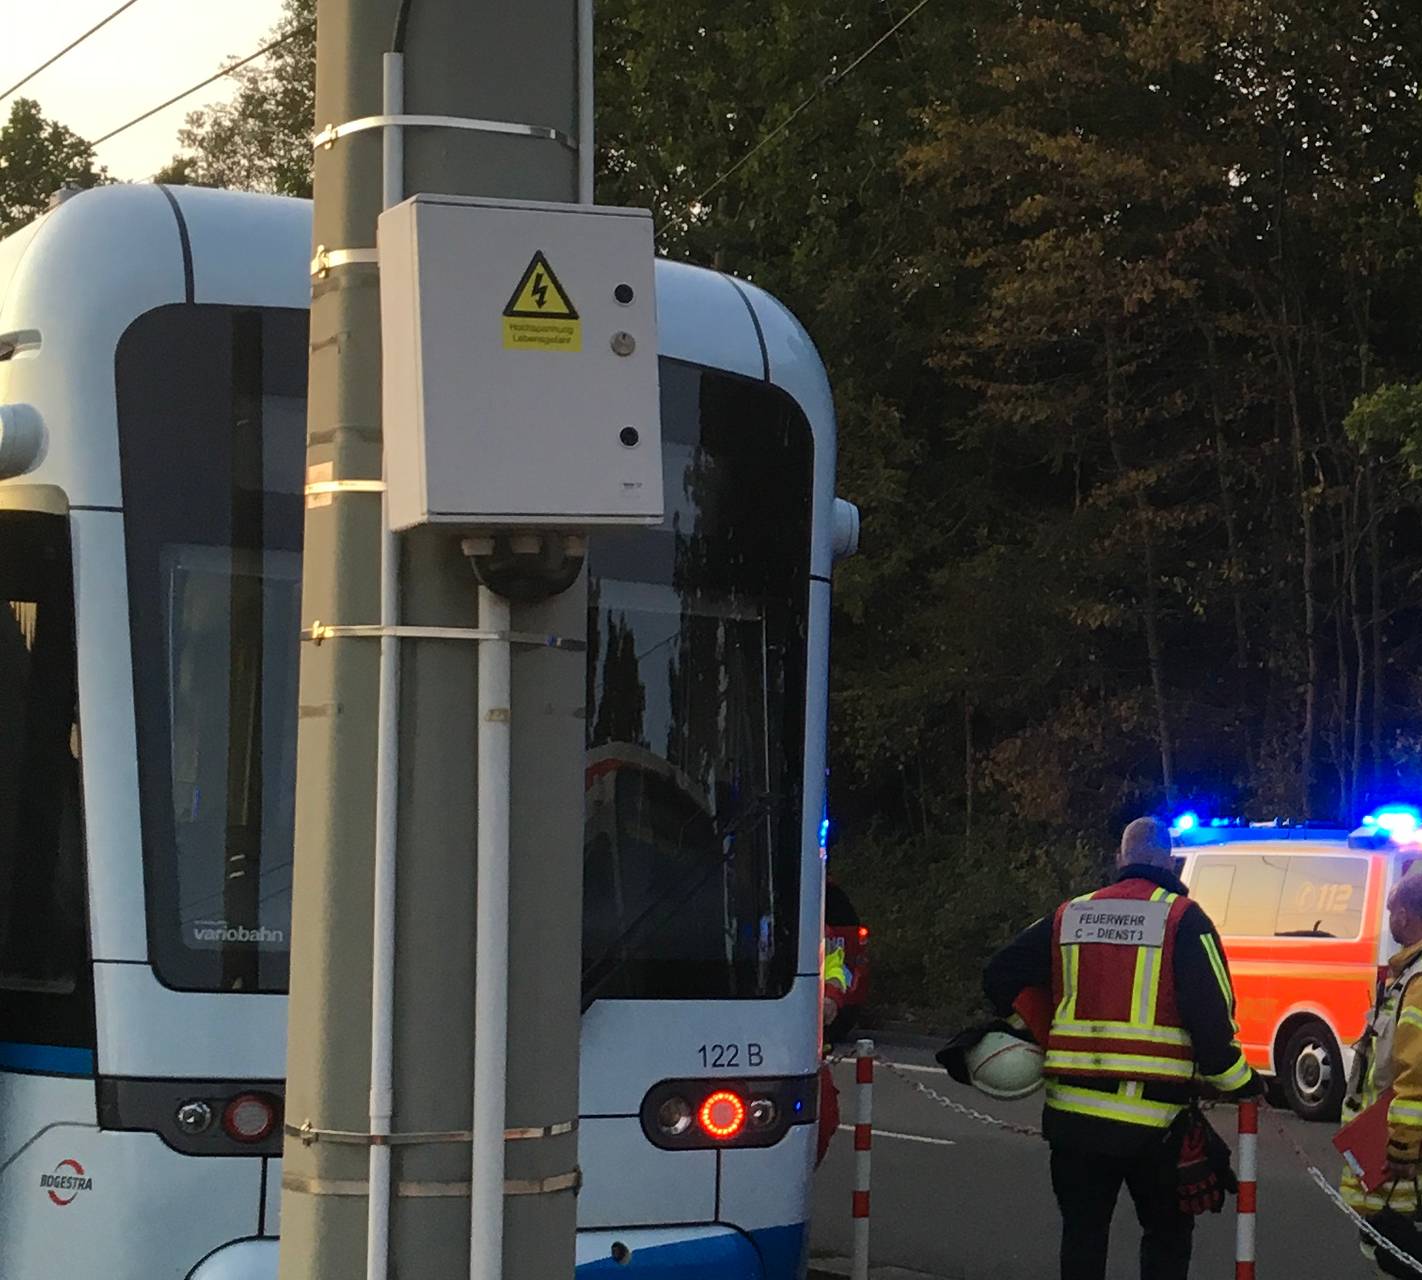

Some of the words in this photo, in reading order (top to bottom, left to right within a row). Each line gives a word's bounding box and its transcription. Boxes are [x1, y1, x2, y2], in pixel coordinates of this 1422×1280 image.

[1317, 884, 1353, 912] 112
[1079, 913, 1146, 927] FEUERWEHR
[193, 925, 284, 942] variobahn
[1075, 928, 1083, 939] C
[698, 1043, 740, 1068] 122
[747, 1043, 764, 1067] B
[40, 1174, 93, 1191] BOGESTRA
